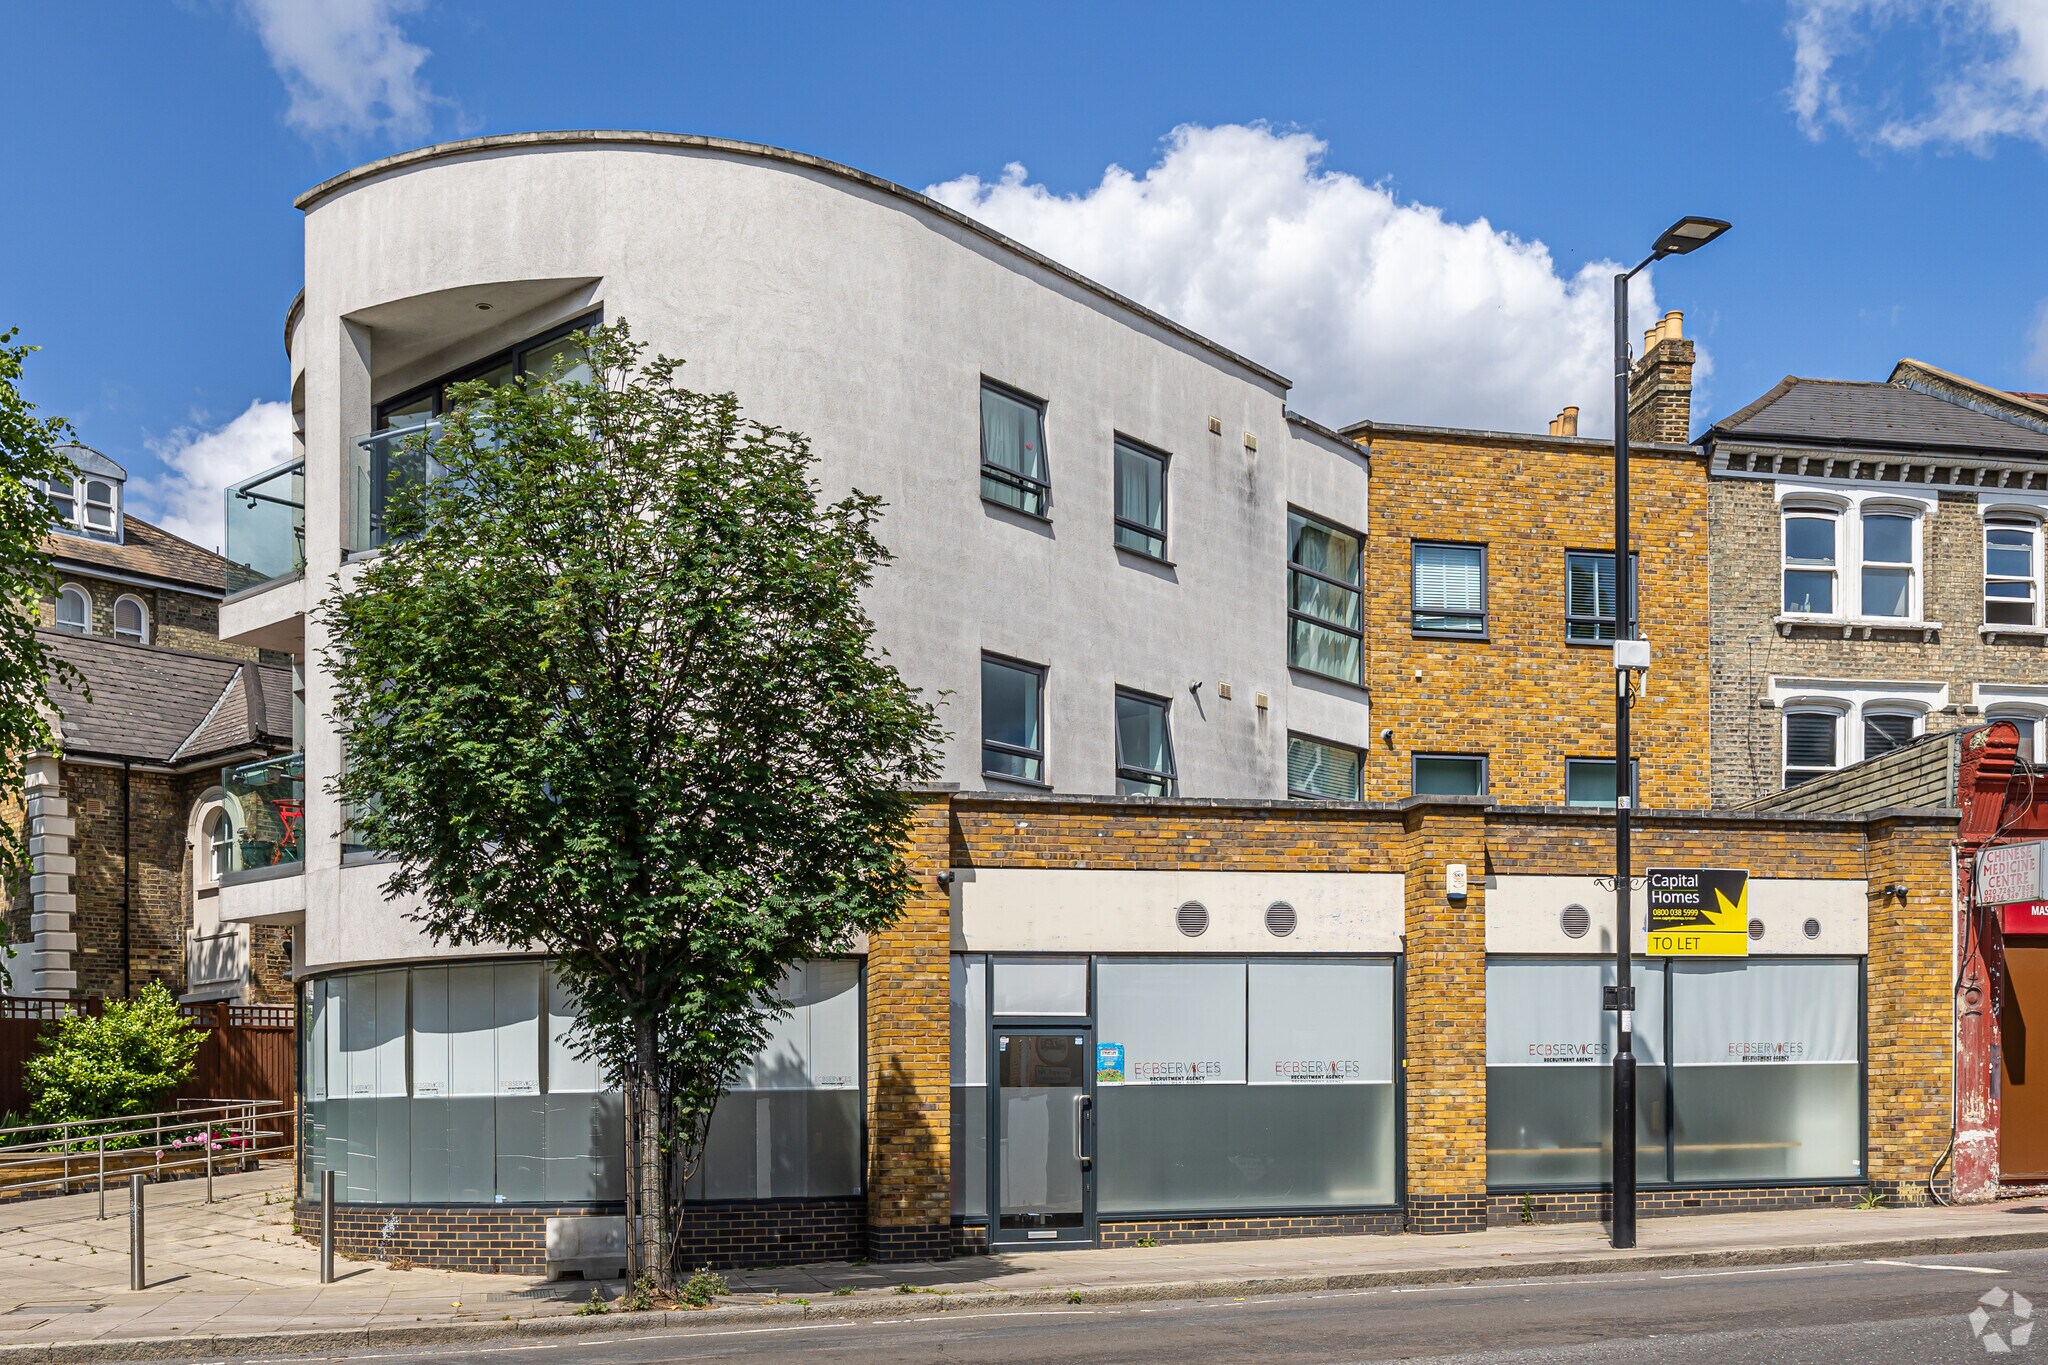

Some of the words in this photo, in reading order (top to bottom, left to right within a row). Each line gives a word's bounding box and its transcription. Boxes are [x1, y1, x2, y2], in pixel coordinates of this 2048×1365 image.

[1987, 846, 2032, 863] CHINESE
[1983, 858, 2035, 876] MEDICINE
[1651, 874, 1699, 889] Capital
[1988, 872, 2029, 888] CENTRE
[1651, 891, 1699, 904] Homes
[1984, 888, 1997, 896] 020
[1653, 908, 1669, 916] 0800
[1670, 908, 1682, 916] 038
[1683, 908, 1699, 916] 5999
[2031, 905, 2048, 916] MAS
[1653, 937, 1672, 950] TO
[1677, 937, 1700, 950] LET
